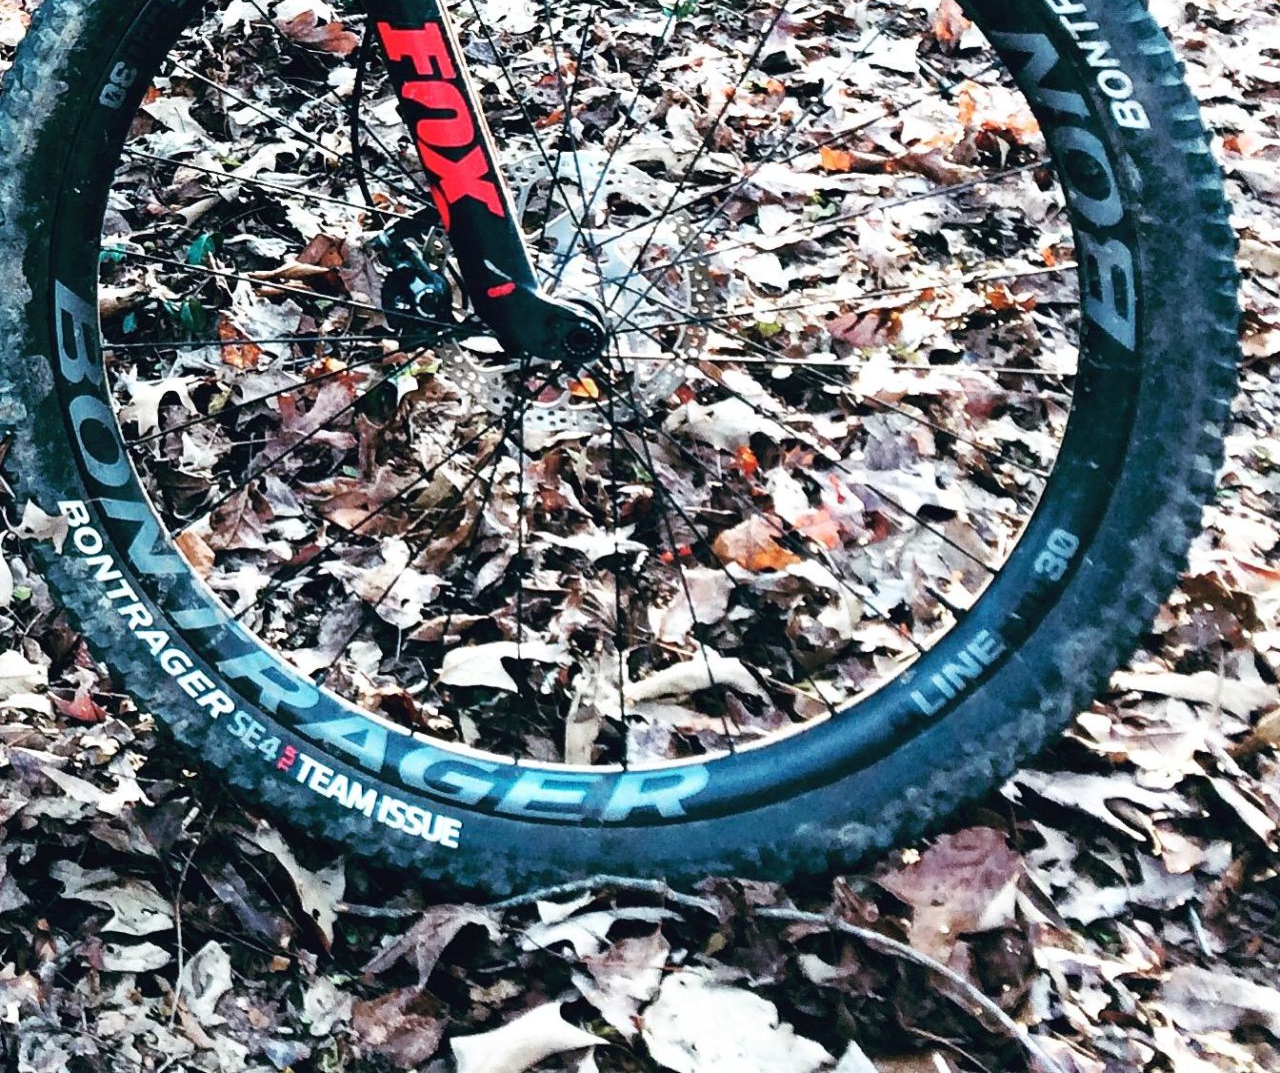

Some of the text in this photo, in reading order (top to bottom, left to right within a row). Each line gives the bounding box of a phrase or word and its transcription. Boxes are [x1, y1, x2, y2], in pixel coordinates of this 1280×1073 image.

[98, 61, 138, 110] 30
[376, 21, 505, 229] FOX
[54, 281, 710, 822] BONTRAGER
[909, 528, 1080, 717] LINE 30
[57, 499, 236, 719] BONTRAGER
[226, 710, 282, 762] SE4
[294, 752, 378, 818] TEAM
[377, 794, 463, 849] ISSUE
